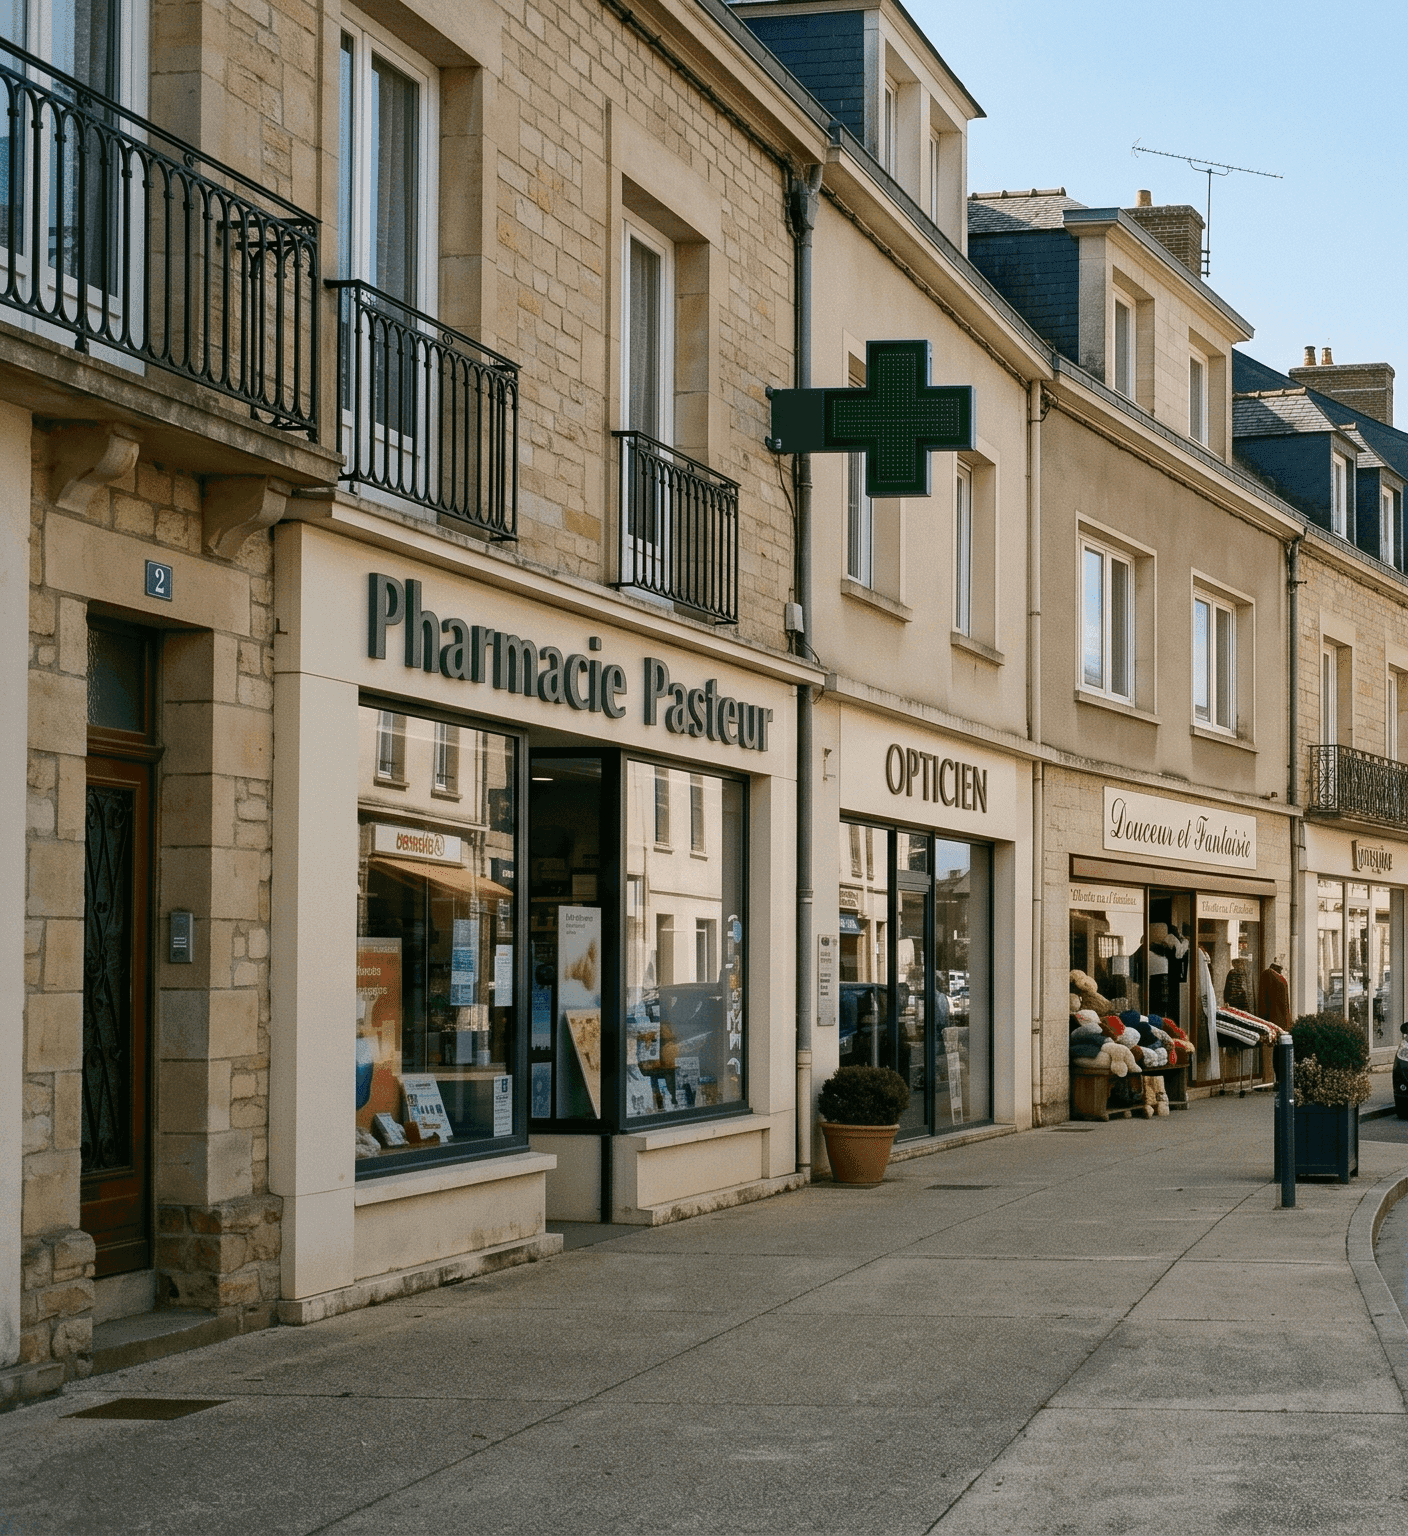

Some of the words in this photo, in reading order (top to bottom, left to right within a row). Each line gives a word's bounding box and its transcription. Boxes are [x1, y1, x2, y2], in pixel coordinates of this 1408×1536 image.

[155, 568, 165, 594] 2
[368, 572, 628, 719] Pharmacie
[644, 657, 774, 752] Pasteur
[885, 743, 988, 814] OPTICIEN
[1110, 797, 1176, 847] Douceur
[1177, 819, 1192, 849] et
[1194, 815, 1251, 859] Fantaisie
